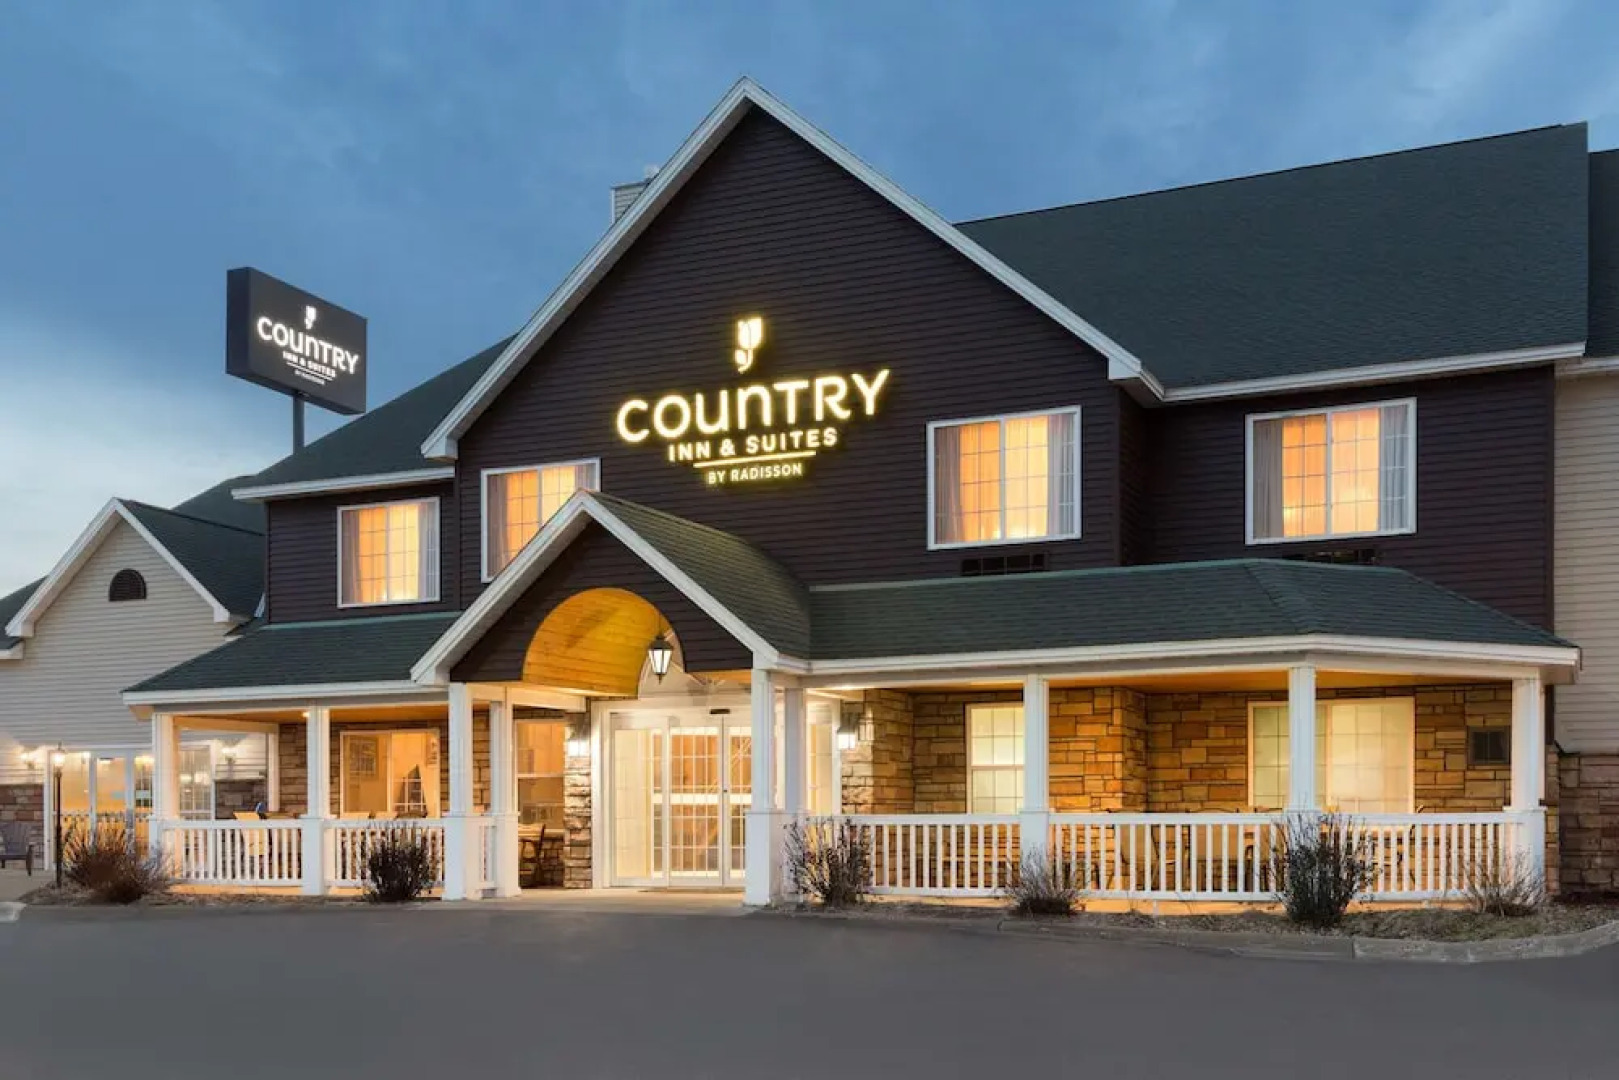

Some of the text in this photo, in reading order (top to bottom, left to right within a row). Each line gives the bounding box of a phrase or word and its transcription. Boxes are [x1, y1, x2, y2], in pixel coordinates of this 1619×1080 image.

[257, 316, 359, 374] COUNTRY
[616, 369, 890, 442] COUNTRY
[668, 427, 838, 461] INN & SUITES
[708, 463, 803, 484] BY RADISSON
